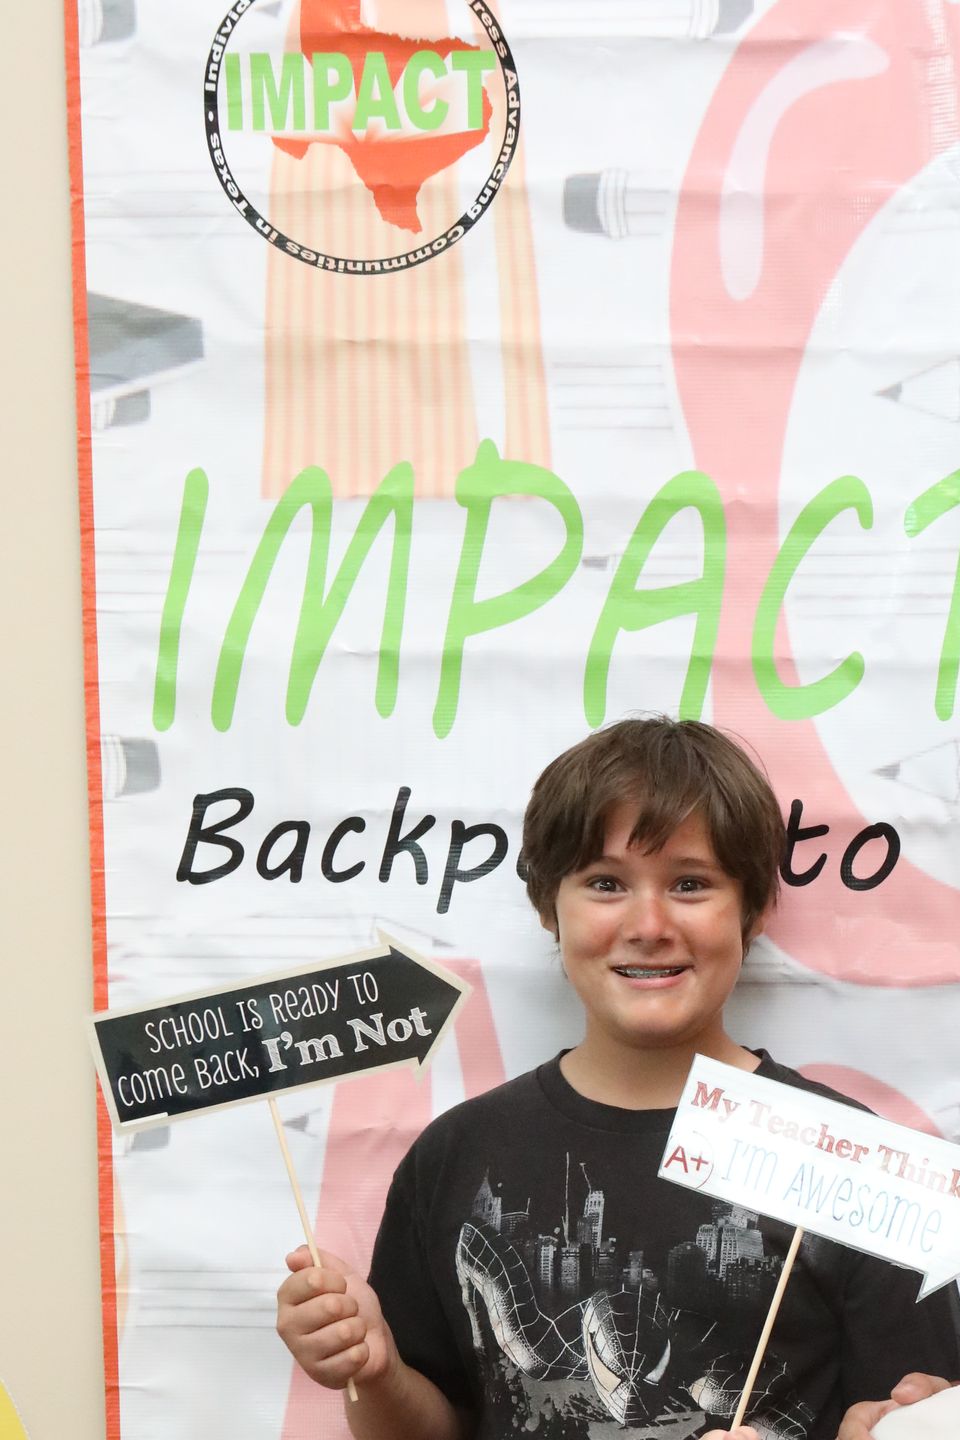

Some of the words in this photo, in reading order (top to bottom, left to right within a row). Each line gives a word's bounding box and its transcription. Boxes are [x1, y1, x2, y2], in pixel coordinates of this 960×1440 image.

[225, 50, 497, 132] IMPACT
[210, 132, 248, 217] Texas
[467, 68, 520, 220] Advancing
[256, 218, 279, 243] in
[285, 225, 465, 272] Communities
[176, 785, 529, 915] Backp
[779, 799, 901, 891] to
[145, 1004, 235, 1054] SCHOOL
[236, 998, 263, 1033] IS
[347, 971, 379, 1004] TO
[262, 1030, 344, 1073] I'm
[346, 1007, 432, 1053] Not
[664, 1145, 709, 1173] A+
[690, 1081, 741, 1123] My
[749, 1099, 870, 1164] Teacher
[721, 1138, 779, 1196] I'm
